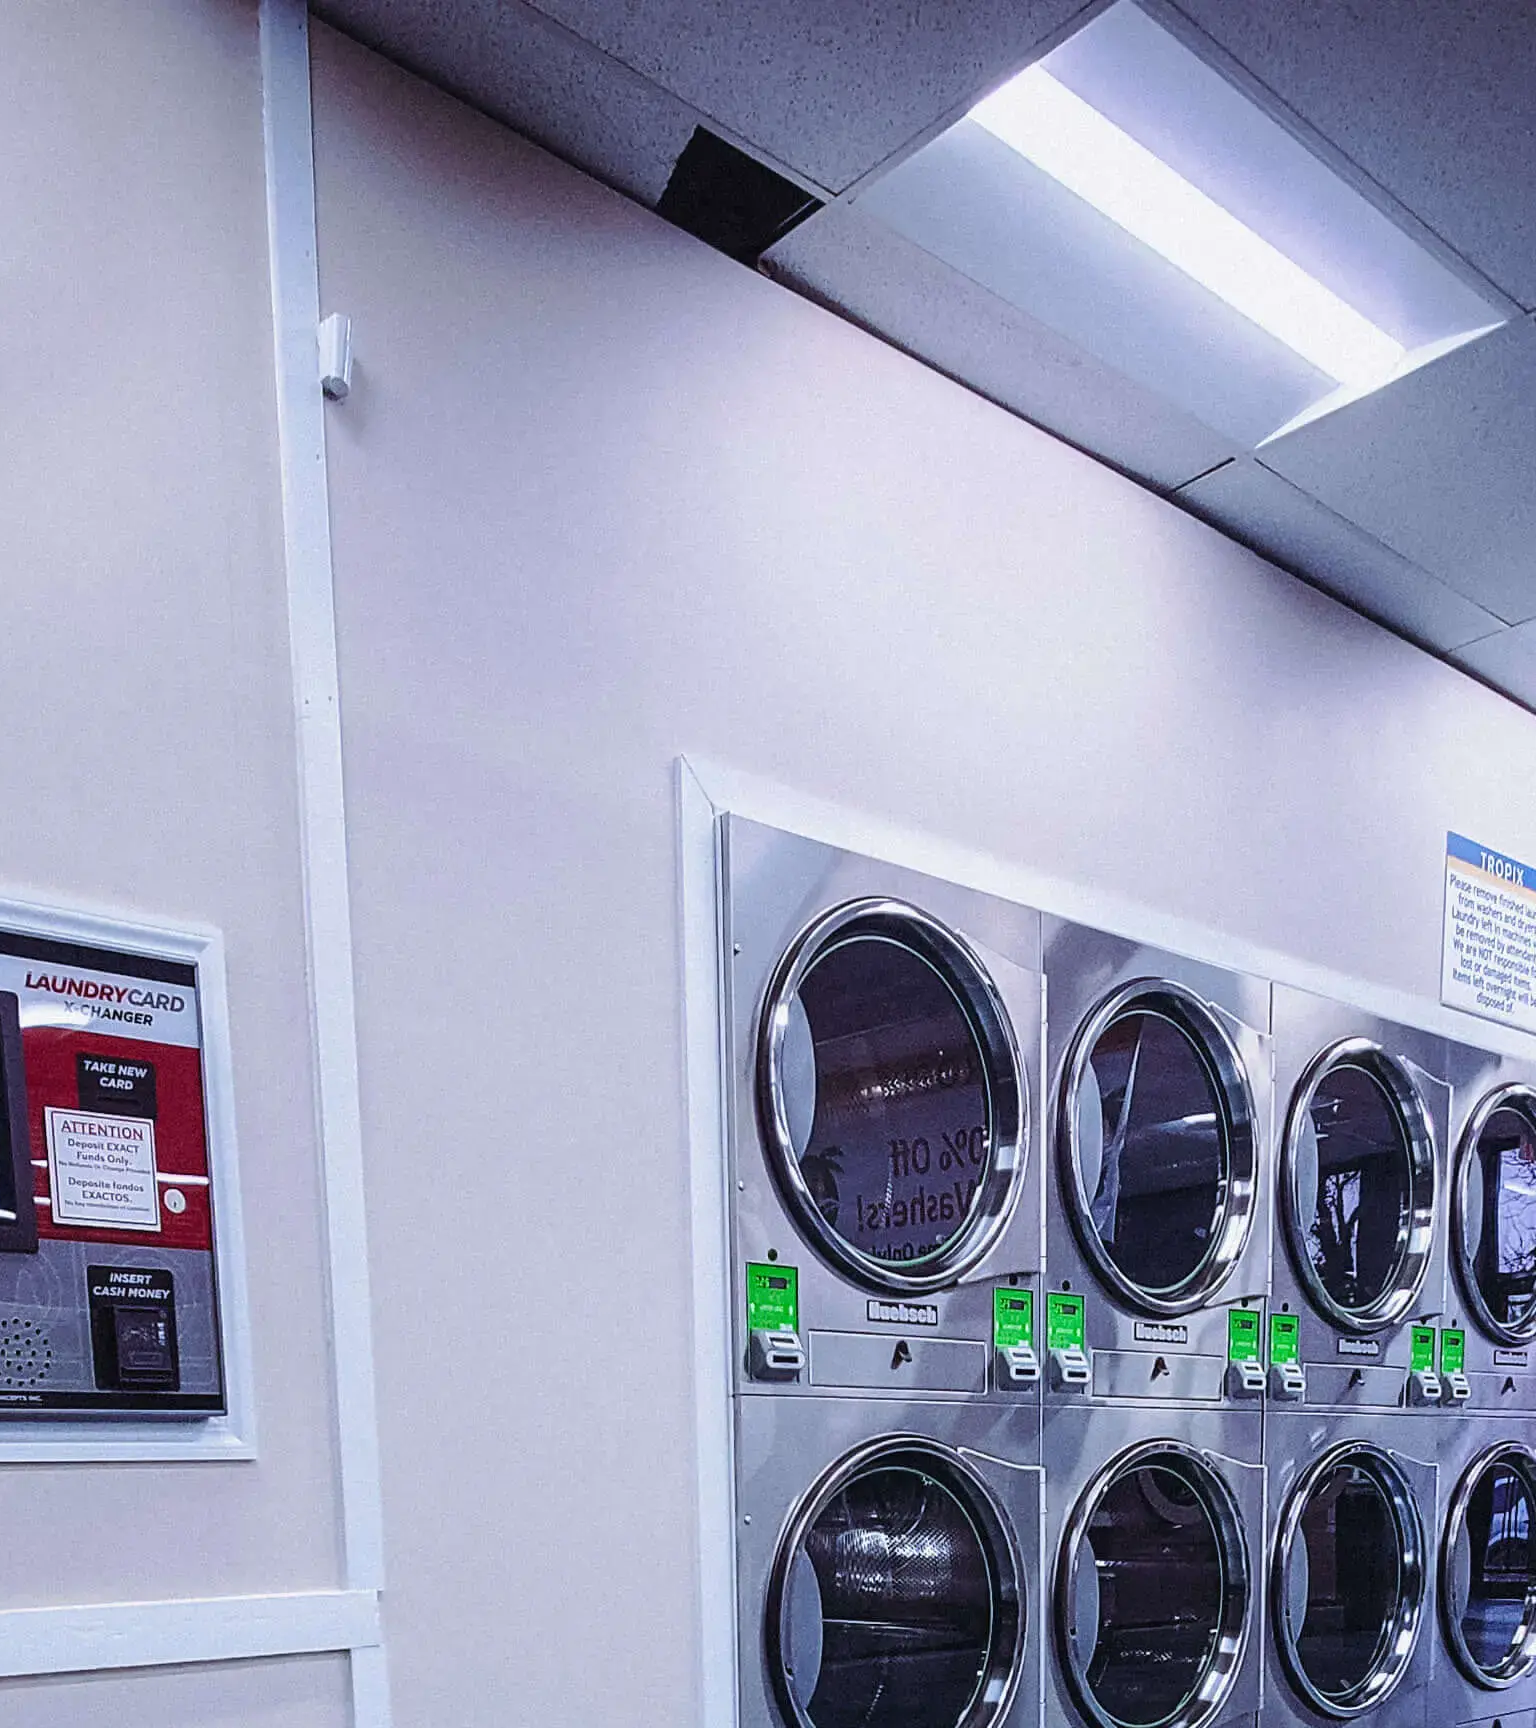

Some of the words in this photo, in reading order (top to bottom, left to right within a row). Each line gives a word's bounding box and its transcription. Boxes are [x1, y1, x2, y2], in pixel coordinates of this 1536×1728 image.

[1480, 852, 1524, 887] TROPIX
[1449, 872, 1473, 894] Please
[1473, 886, 1498, 905] remove
[1458, 892, 1475, 910] from
[1451, 904, 1480, 929] Laundry
[1481, 916, 1493, 933] left
[1466, 929, 1496, 949] removed
[1478, 947, 1493, 961] NOT
[25, 971, 185, 1013] LAUNDRYCARD
[64, 1000, 154, 1027] X-CHANGER
[84, 1060, 116, 1074] TAKE
[118, 1065, 148, 1078] NEW
[99, 1077, 134, 1090] CARD
[61, 1120, 144, 1142] ATTENTION
[68, 1138, 104, 1150] Deposit
[107, 1143, 139, 1154] EXACT
[76, 1151, 105, 1162] Funds
[107, 1155, 133, 1166] Only.
[68, 1177, 110, 1190] Deposite
[113, 1181, 144, 1193] fondos
[82, 1190, 133, 1203] EXACTOS.
[110, 1272, 153, 1285] INSERT
[93, 1286, 126, 1297] CASH
[128, 1288, 170, 1299] MONEY
[868, 1301, 938, 1324] Huebsch
